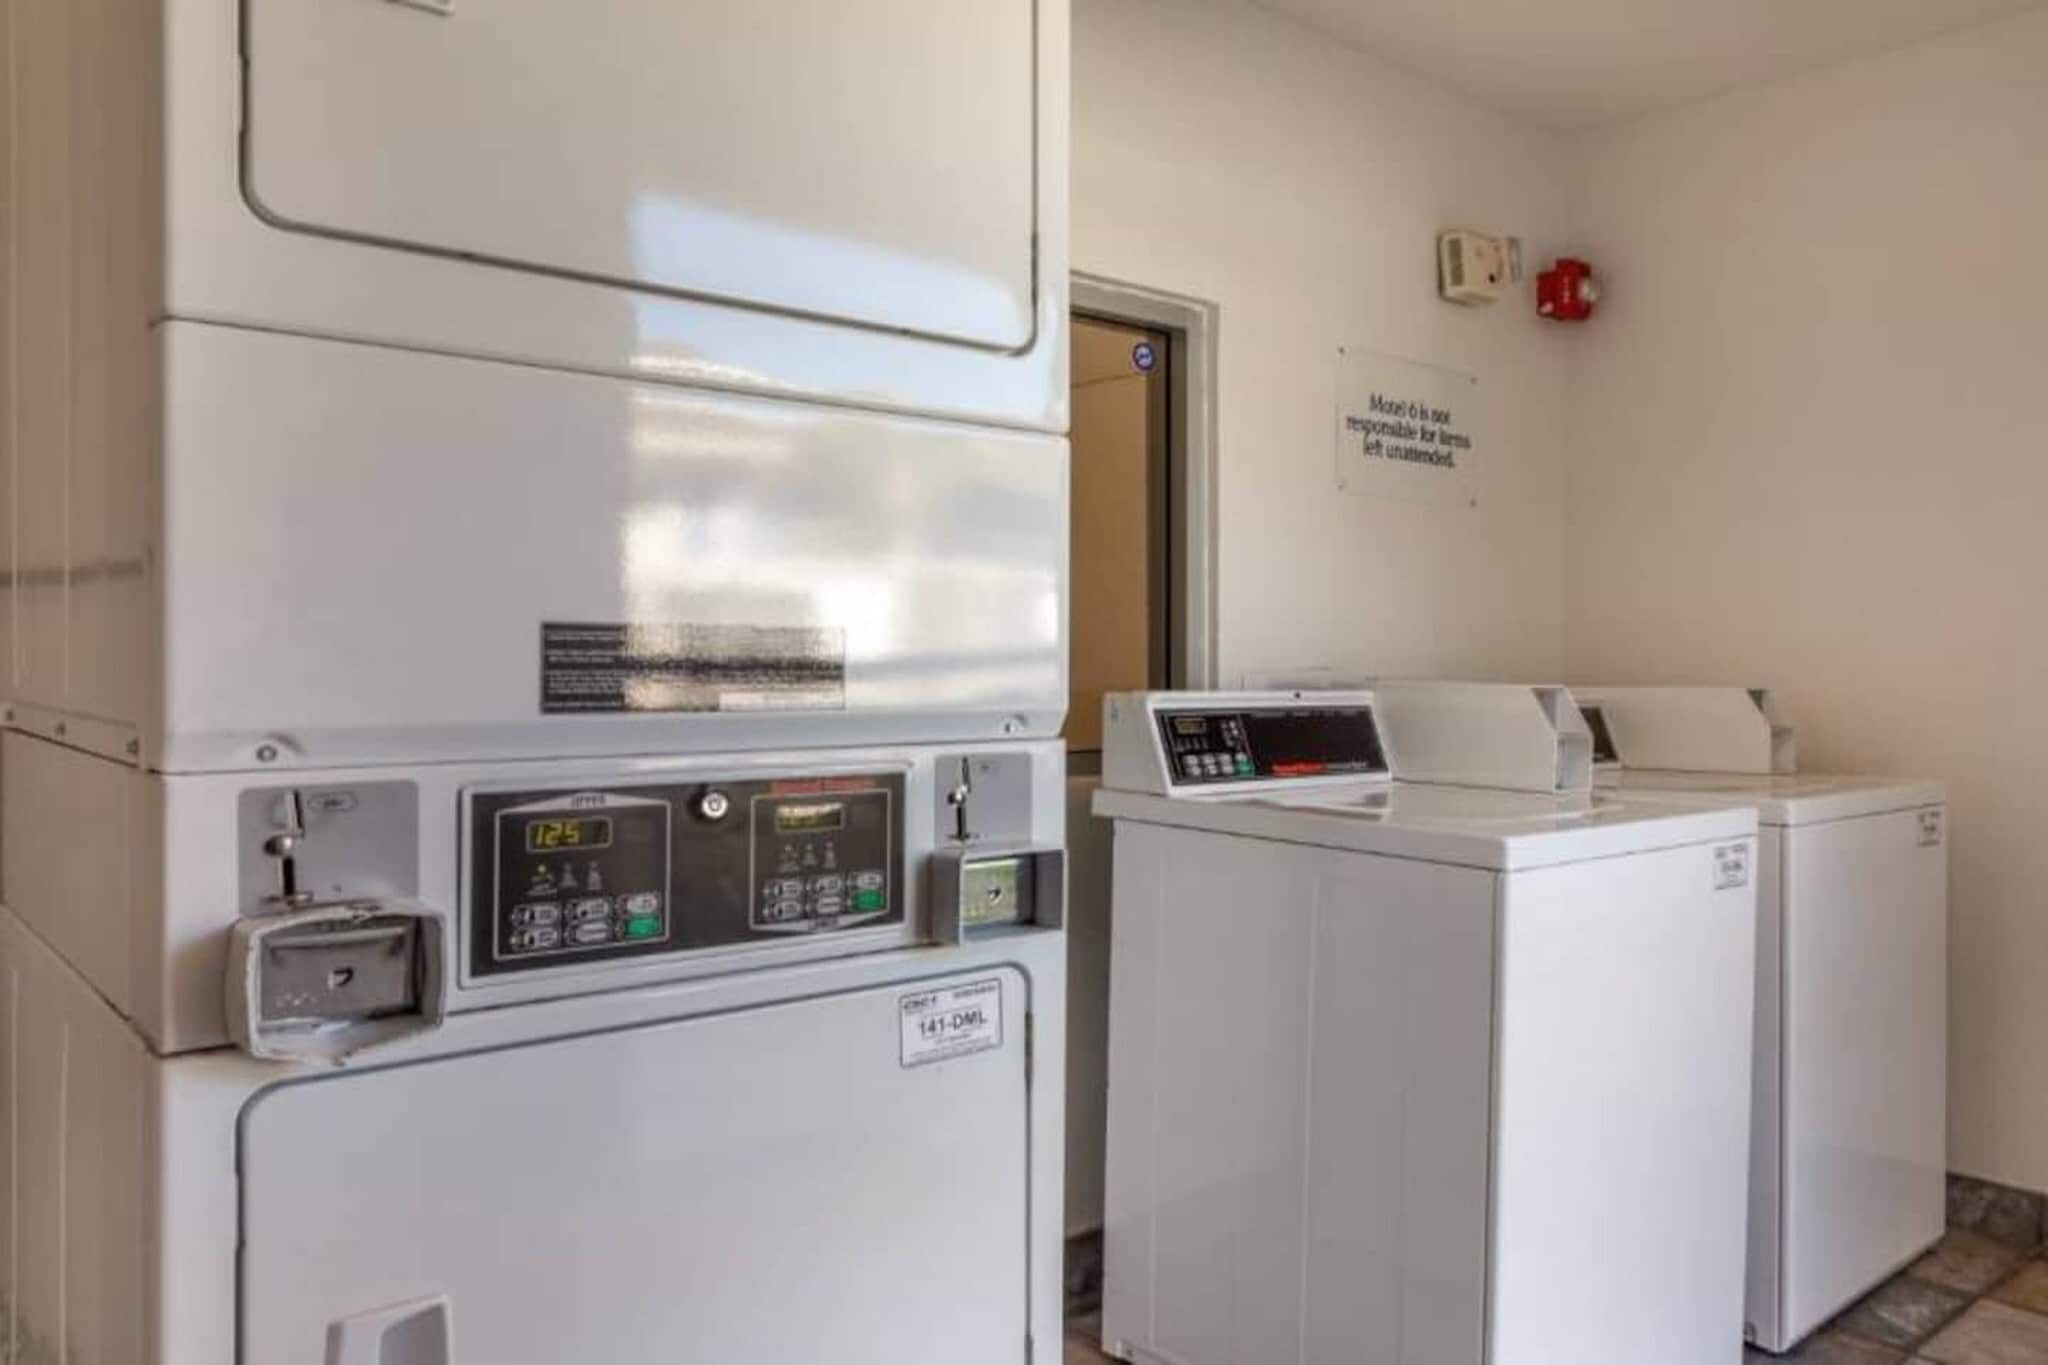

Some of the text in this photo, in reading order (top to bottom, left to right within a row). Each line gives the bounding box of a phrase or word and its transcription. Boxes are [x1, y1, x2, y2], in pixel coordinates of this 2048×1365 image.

[1369, 392, 1451, 424] Motel 6 is not
[1346, 415, 1471, 449] responsible for items
[1363, 437, 1455, 468] left unattended.
[535, 820, 581, 847] 125
